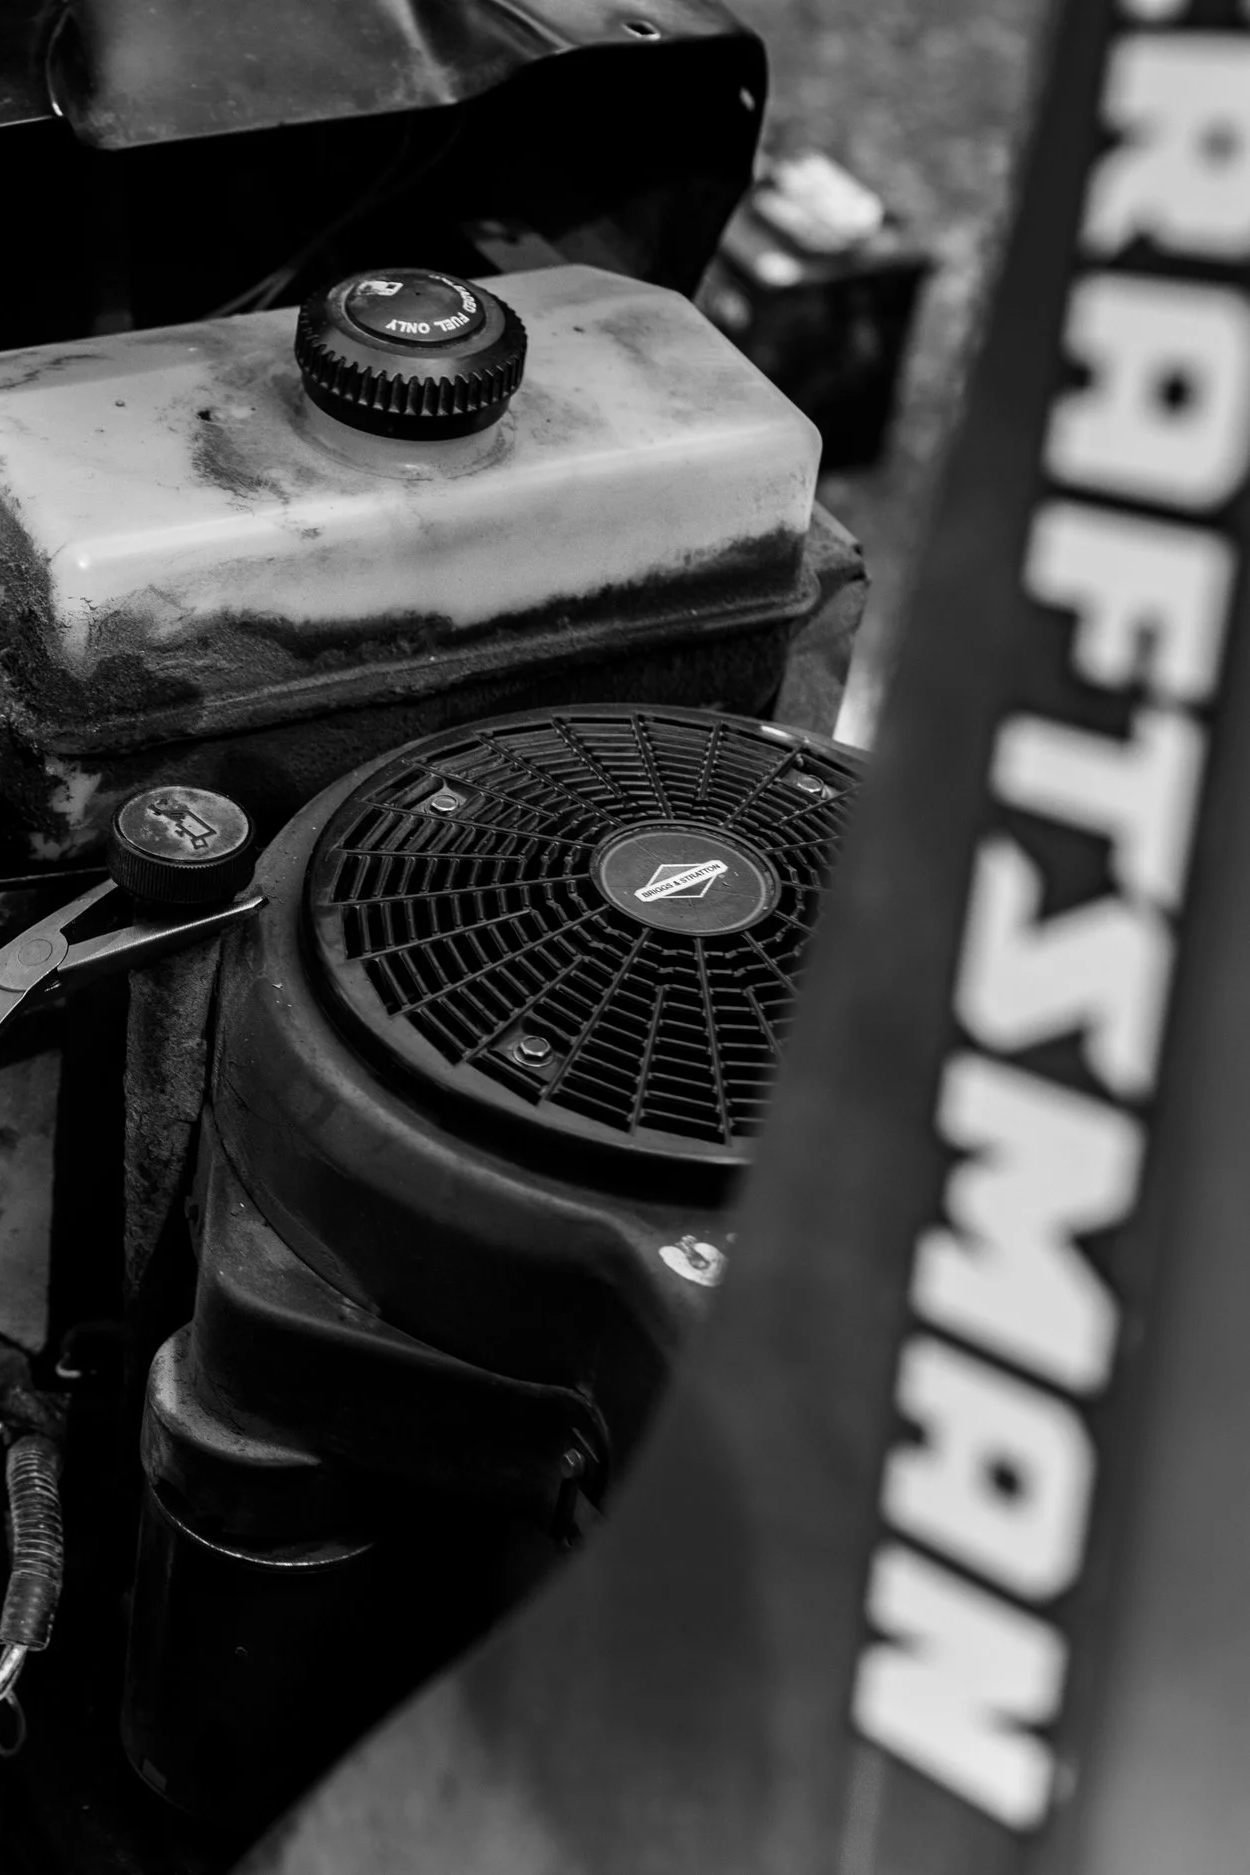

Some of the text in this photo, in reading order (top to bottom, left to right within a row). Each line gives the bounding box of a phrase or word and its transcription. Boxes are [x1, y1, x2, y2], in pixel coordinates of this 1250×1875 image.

[386, 319, 430, 334] ONLY
[433, 311, 470, 332] FUEL
[641, 882, 673, 898] BRIGGS
[681, 864, 721, 883] STRATTON
[852, 0, 1250, 1832] RAFTSMAN
